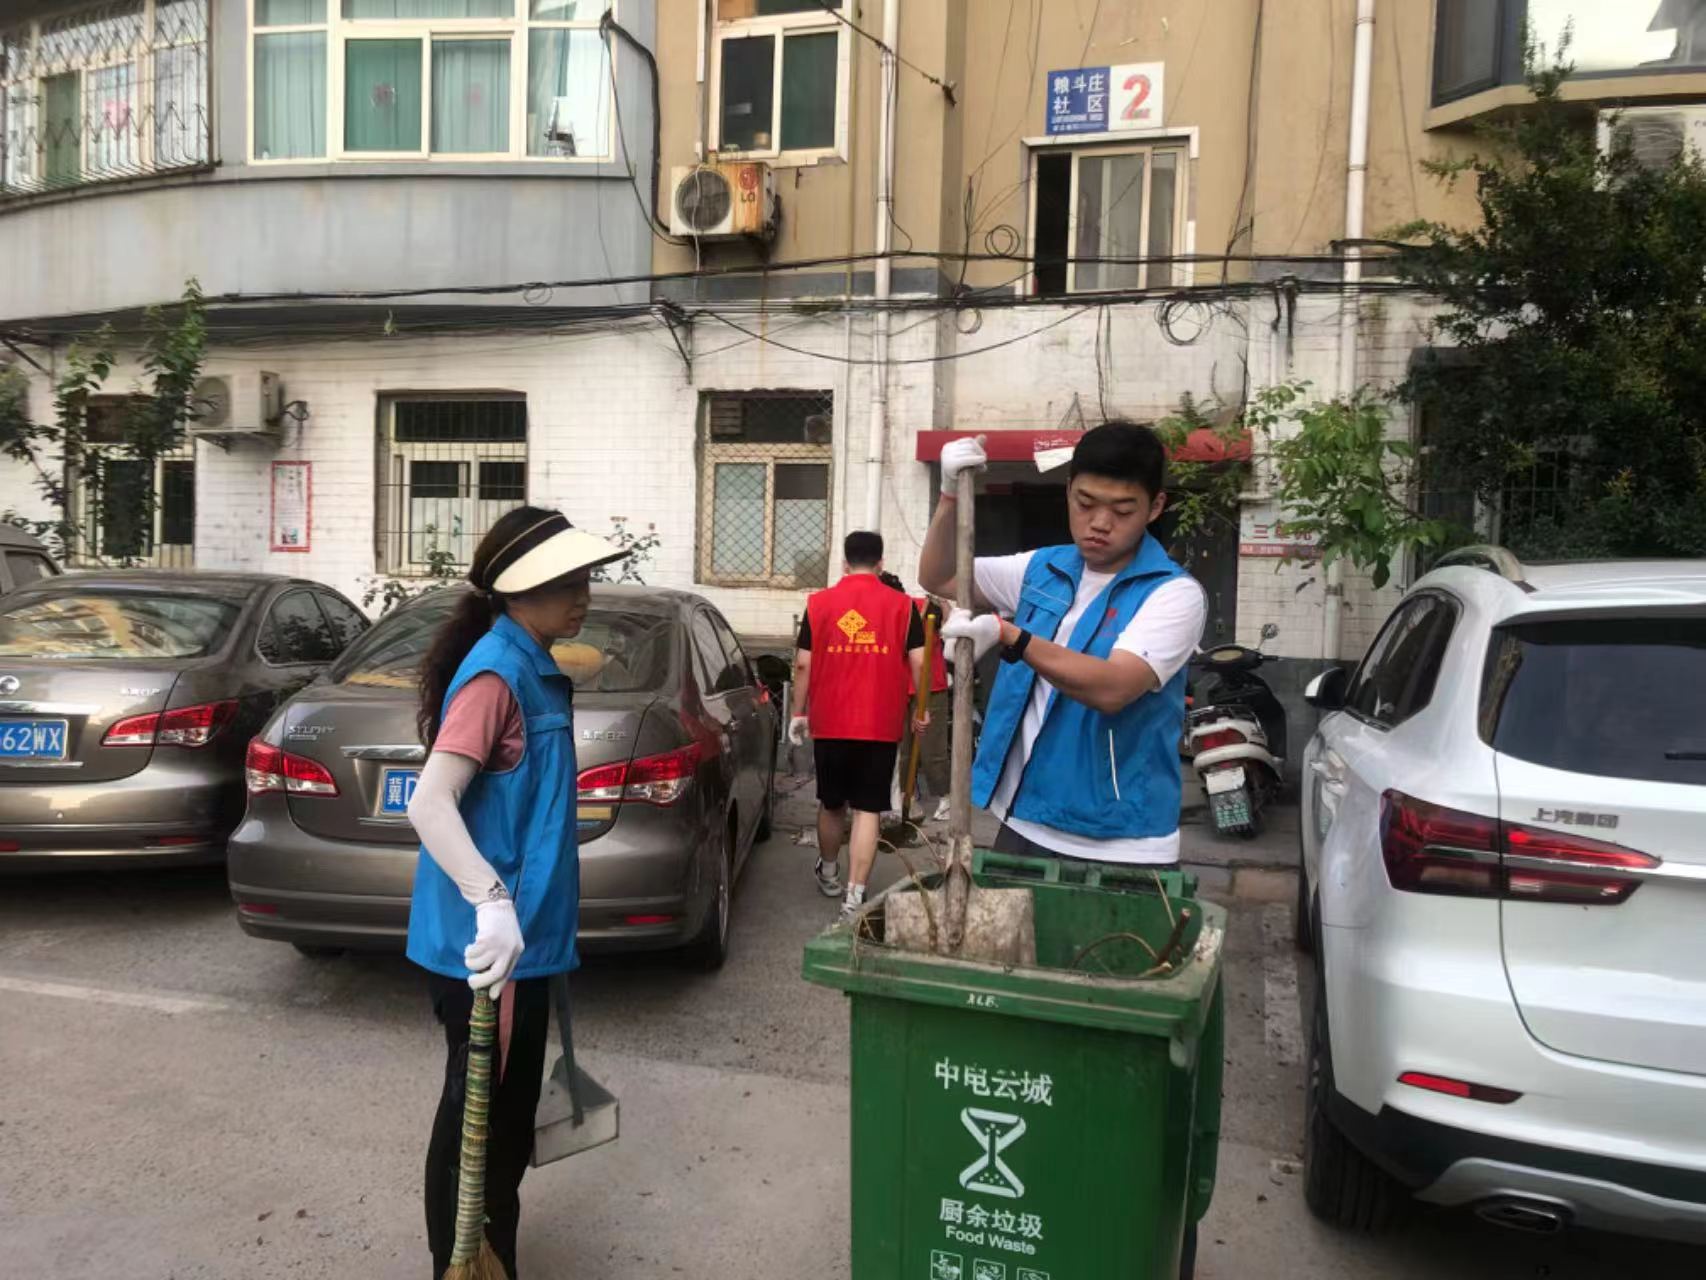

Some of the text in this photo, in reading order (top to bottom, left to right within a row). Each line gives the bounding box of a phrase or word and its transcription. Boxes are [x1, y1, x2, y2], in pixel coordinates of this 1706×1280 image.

[1053, 94, 1104, 114] 社区
[1120, 74, 1152, 120] 2
[0, 727, 61, 751] 62WX
[935, 1056, 1053, 1106] 中电云城
[940, 1198, 1044, 1240] 厨余垃圾
[945, 1225, 1036, 1256] Food Waste
